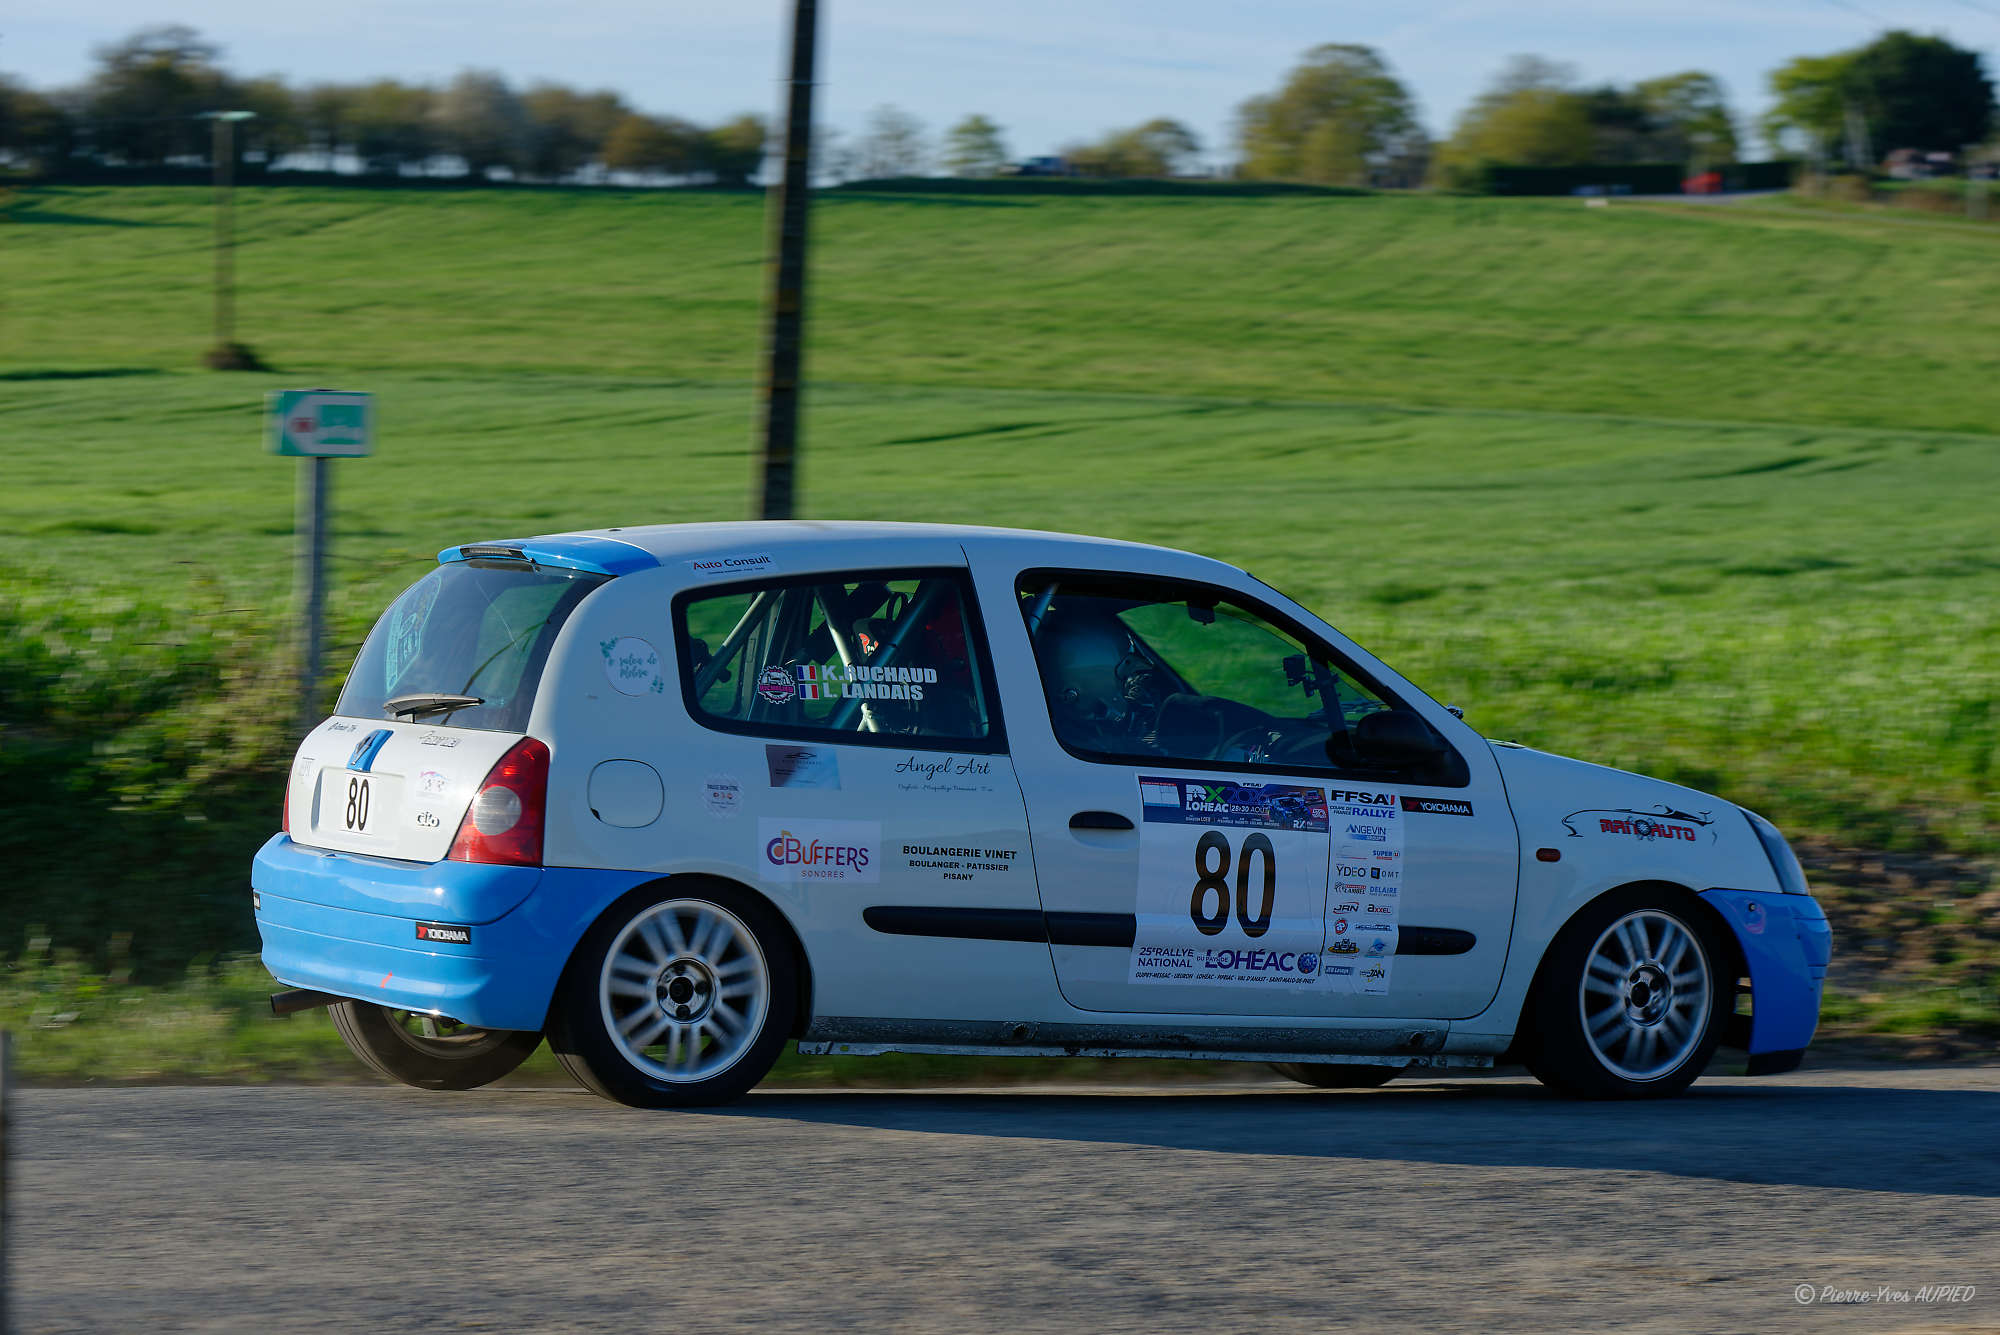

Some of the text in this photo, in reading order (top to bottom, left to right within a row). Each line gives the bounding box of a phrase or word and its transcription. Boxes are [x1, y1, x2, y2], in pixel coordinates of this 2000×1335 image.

[694, 555, 771, 570] Auto Consult
[823, 682, 924, 700] L. LANDAIS
[895, 756, 991, 781] Angel Art
[346, 777, 369, 831] 80
[1331, 790, 1389, 805] FFSA
[1186, 801, 1229, 813] LOHEAC
[1352, 807, 1395, 819] RALLYE
[1420, 802, 1470, 814] YOKOHAMA
[1345, 823, 1386, 835] ANGEVIN
[903, 845, 1017, 860] BOULANGERIE VINET
[909, 860, 1009, 871] BOULANGER PATISSIER
[801, 870, 845, 878] SONORES
[943, 873, 974, 881] PISANY
[1190, 830, 1275, 938] 80
[1156, 948, 1194, 957] RALLYE
[1138, 958, 1193, 968] NATIONAL
[1205, 949, 1295, 971] LOHÉAC
